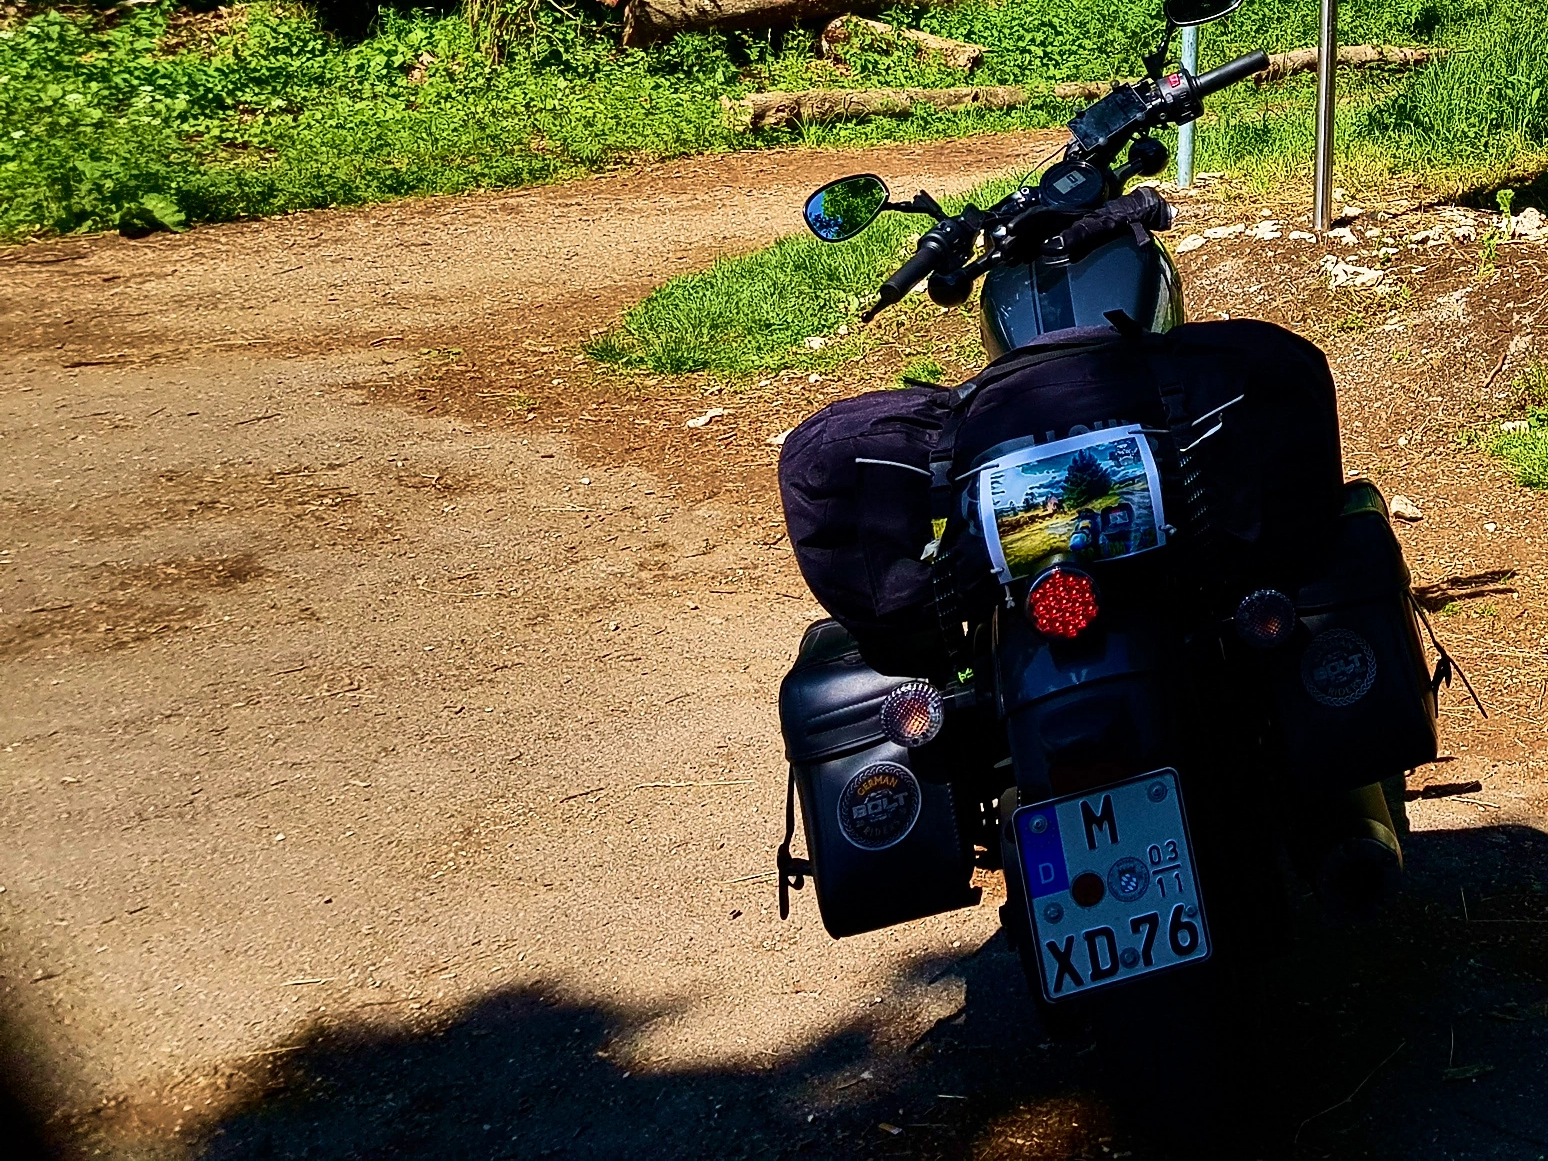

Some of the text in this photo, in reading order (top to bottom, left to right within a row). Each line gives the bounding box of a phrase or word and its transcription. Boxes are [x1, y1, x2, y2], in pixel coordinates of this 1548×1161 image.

[857, 775, 898, 796] GERMAN
[852, 792, 909, 819] BOLT
[1079, 794, 1119, 850] M
[1148, 839, 1179, 865] 03
[1038, 863, 1055, 884] D
[1155, 871, 1183, 898] 11
